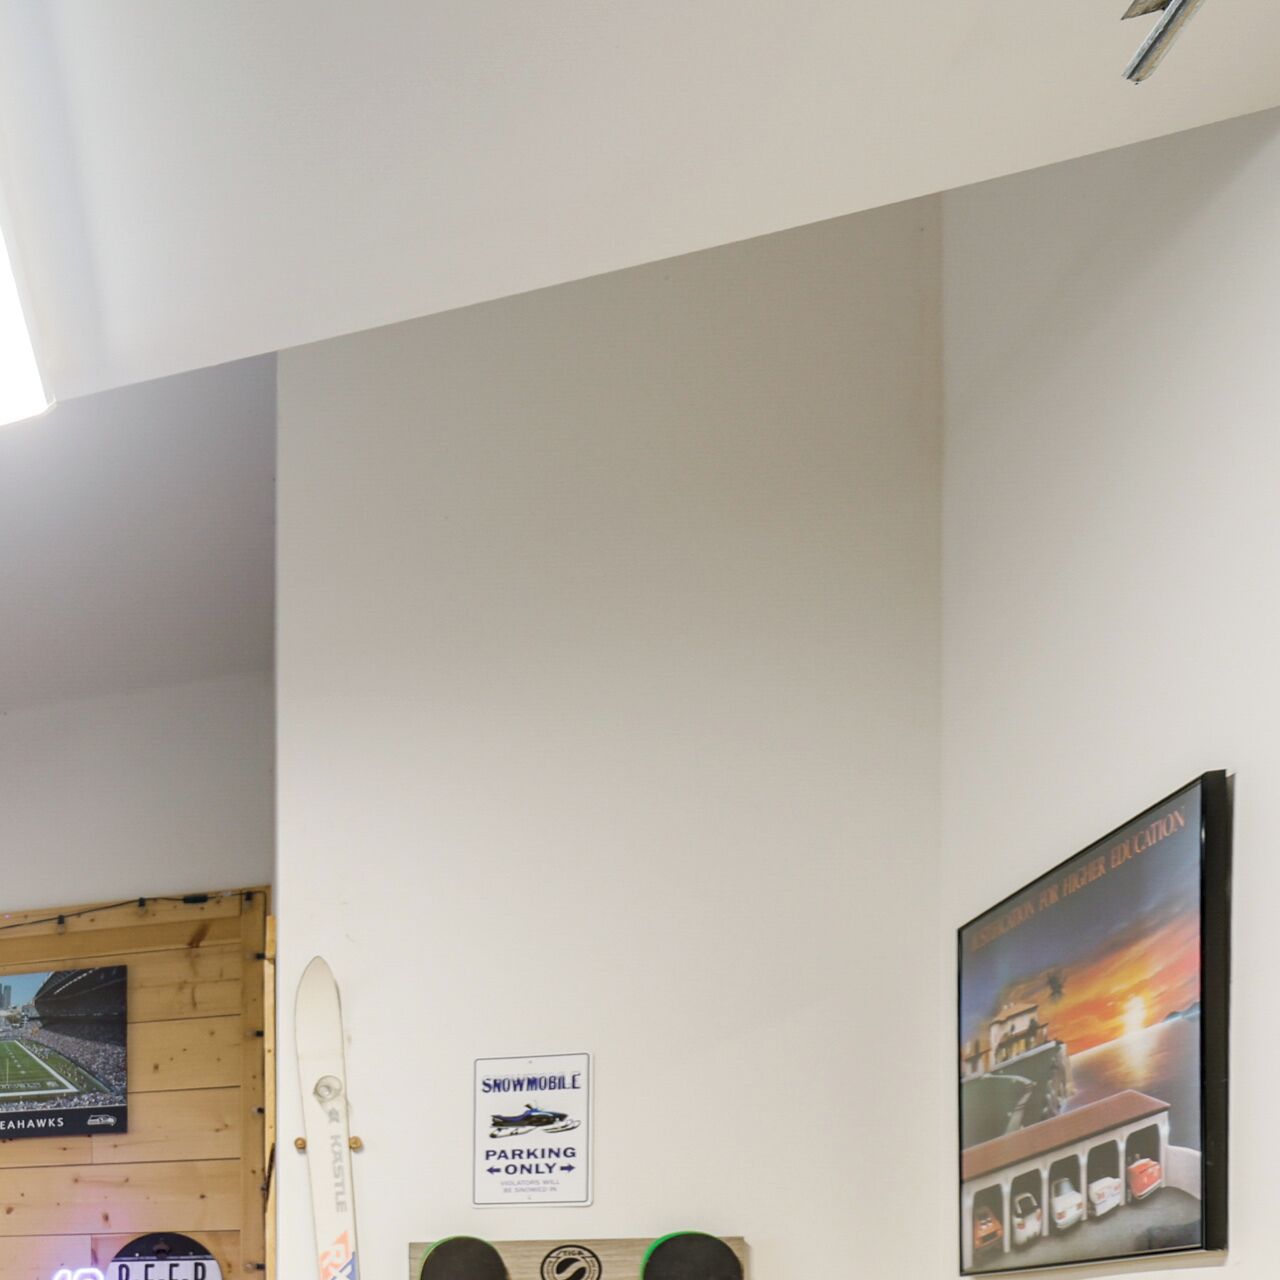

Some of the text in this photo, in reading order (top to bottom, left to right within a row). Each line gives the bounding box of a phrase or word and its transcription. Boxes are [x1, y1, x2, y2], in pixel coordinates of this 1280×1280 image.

[1039, 882, 1060, 912] FOR
[1064, 857, 1106, 896] HIGHER
[1111, 810, 1185, 868] EDUCATION
[481, 1072, 582, 1093] SNOWMOBILE
[485, 1147, 577, 1160] PARKING
[504, 1163, 557, 1175] ONLY
